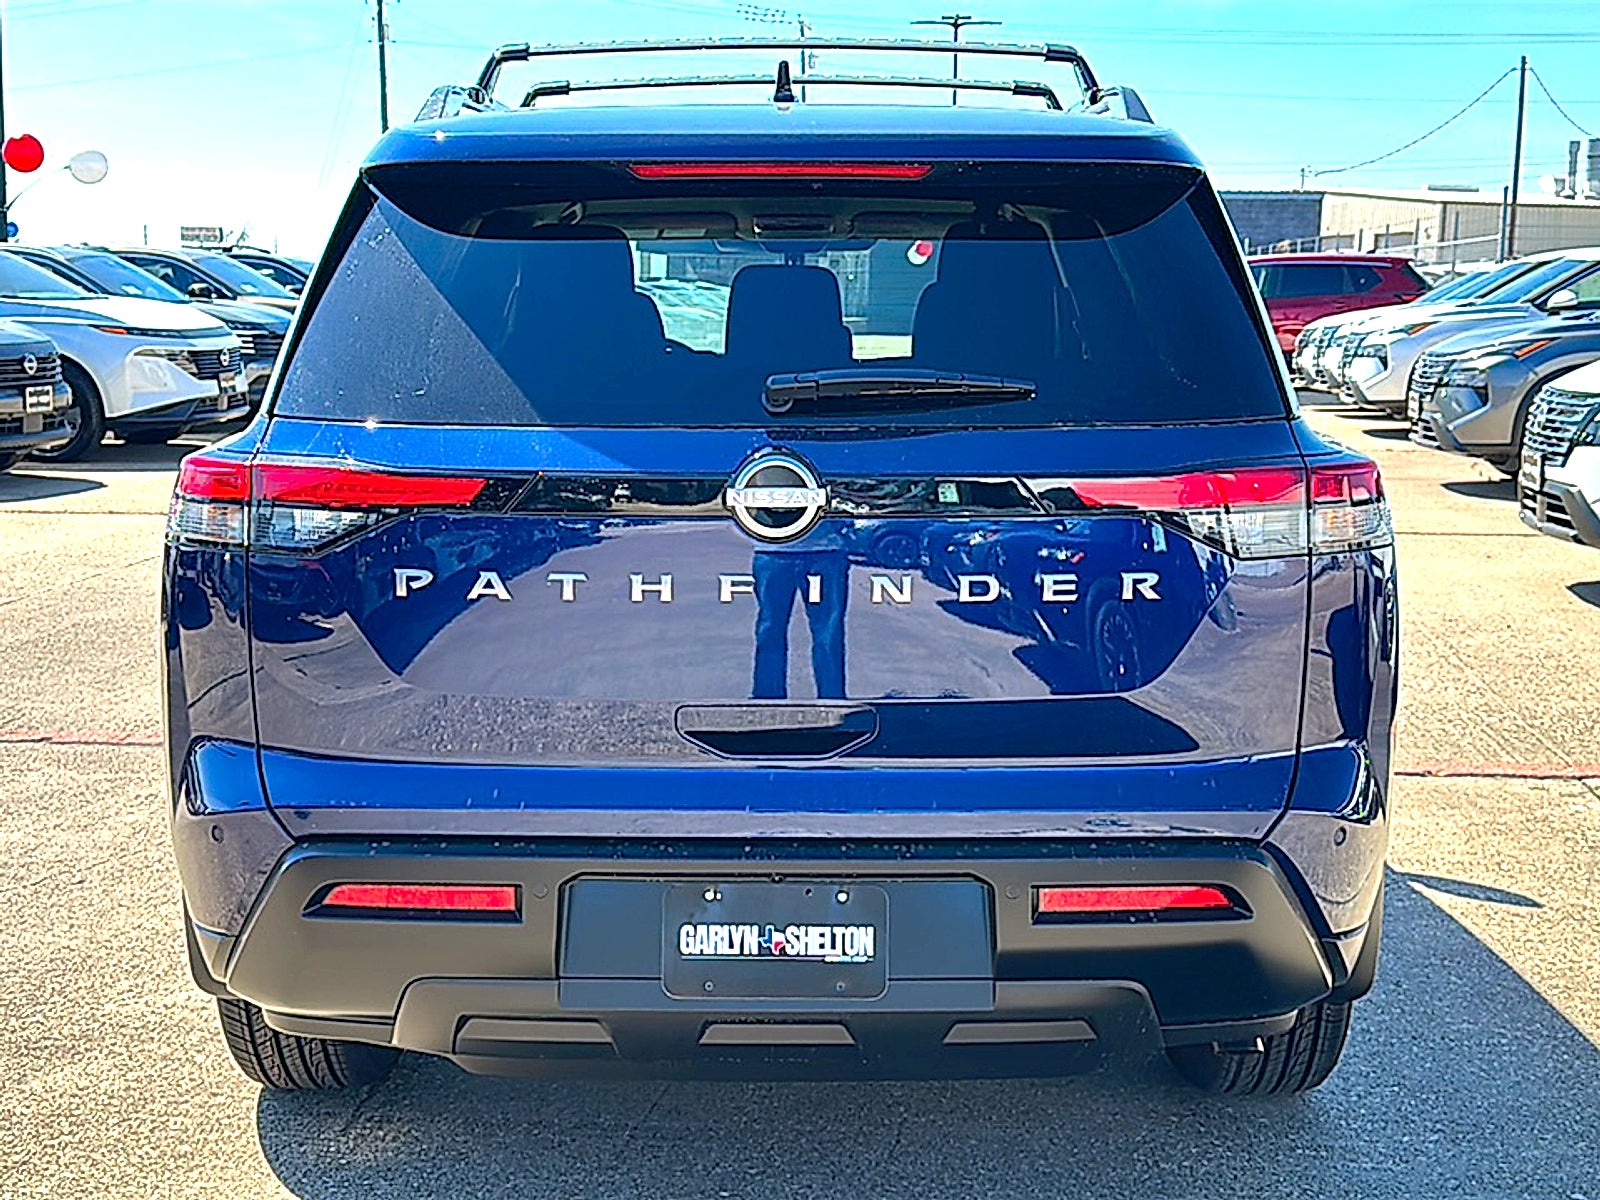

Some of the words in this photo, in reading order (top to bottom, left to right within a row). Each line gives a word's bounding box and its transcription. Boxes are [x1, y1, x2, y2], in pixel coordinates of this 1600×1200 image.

[727, 489, 823, 505] NISSAN
[393, 568, 1162, 603] PATHFINDER
[679, 924, 759, 955] GARLYN
[784, 925, 875, 956] SHELTON
